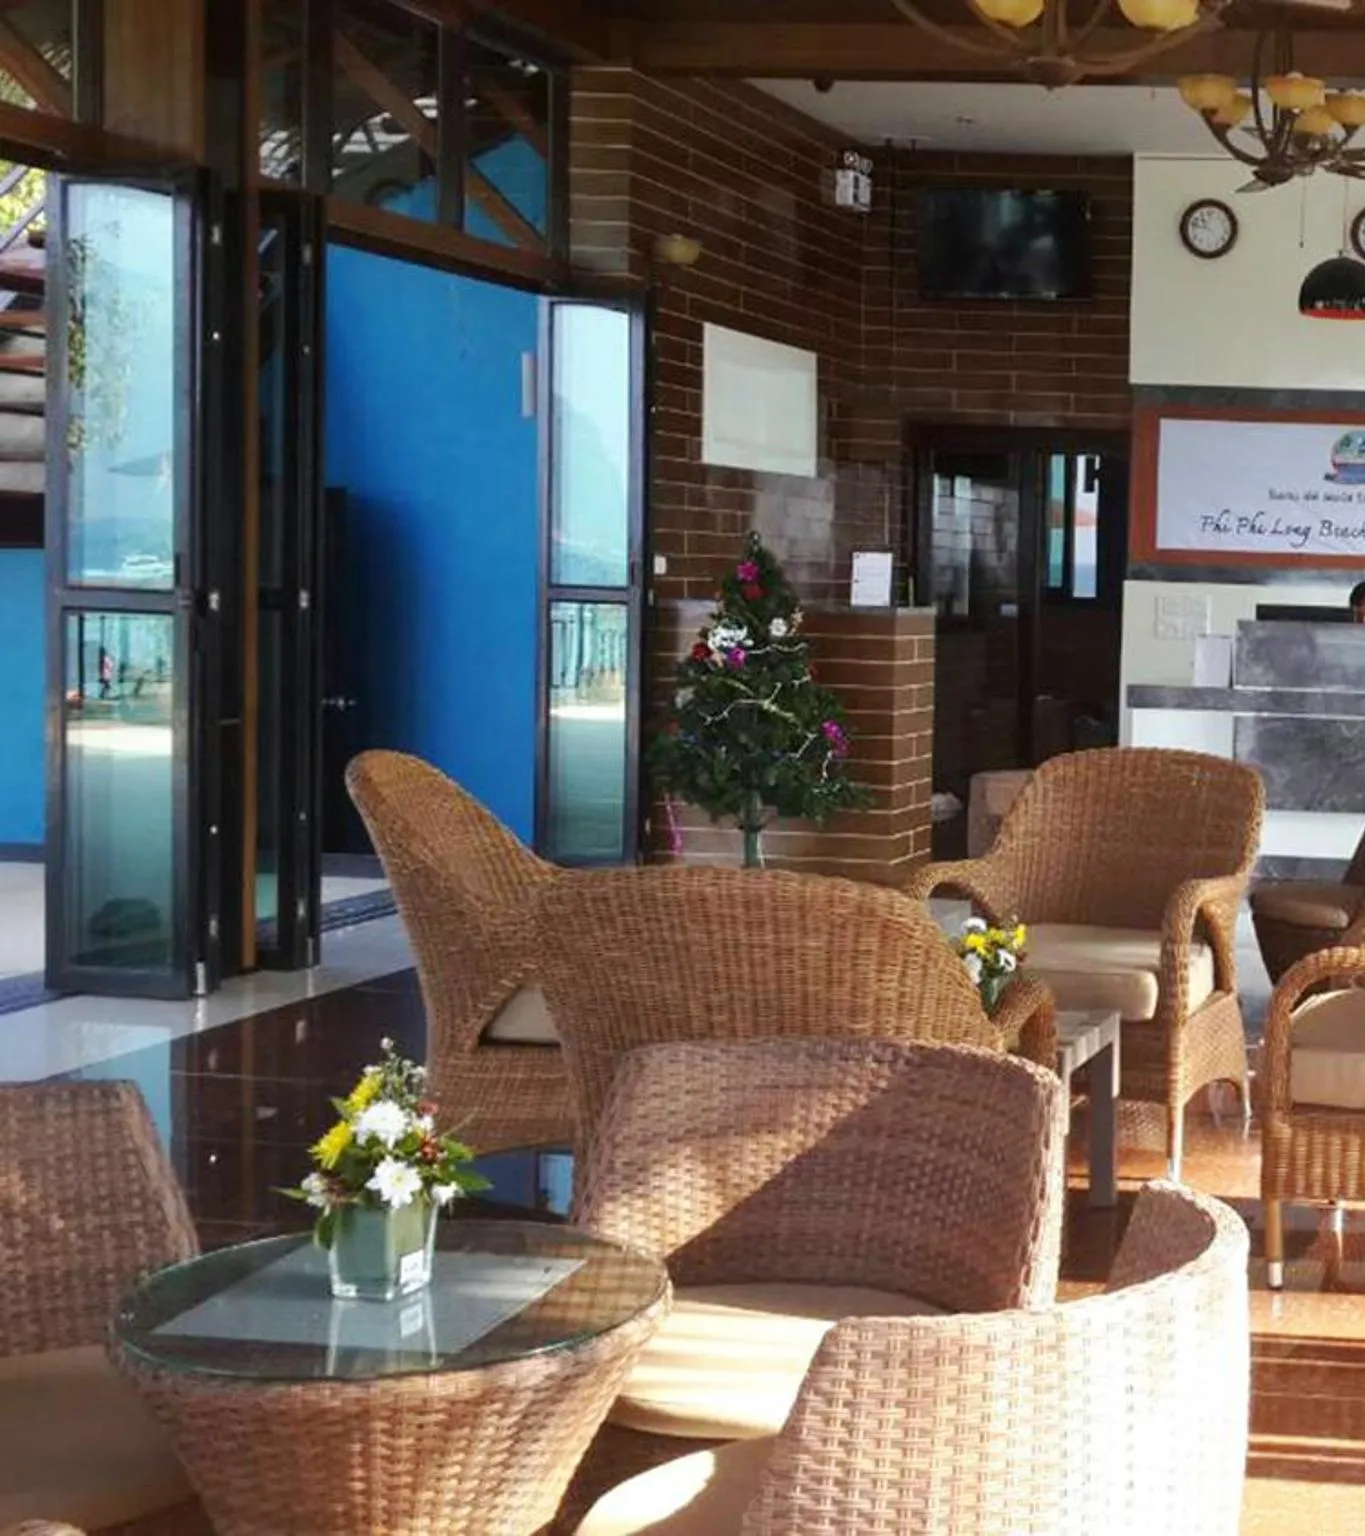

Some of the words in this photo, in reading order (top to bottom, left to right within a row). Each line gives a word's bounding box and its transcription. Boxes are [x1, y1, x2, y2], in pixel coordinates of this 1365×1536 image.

[1200, 509, 1231, 533] Phi
[1236, 511, 1266, 535] Phi
[1269, 517, 1312, 548] Long
